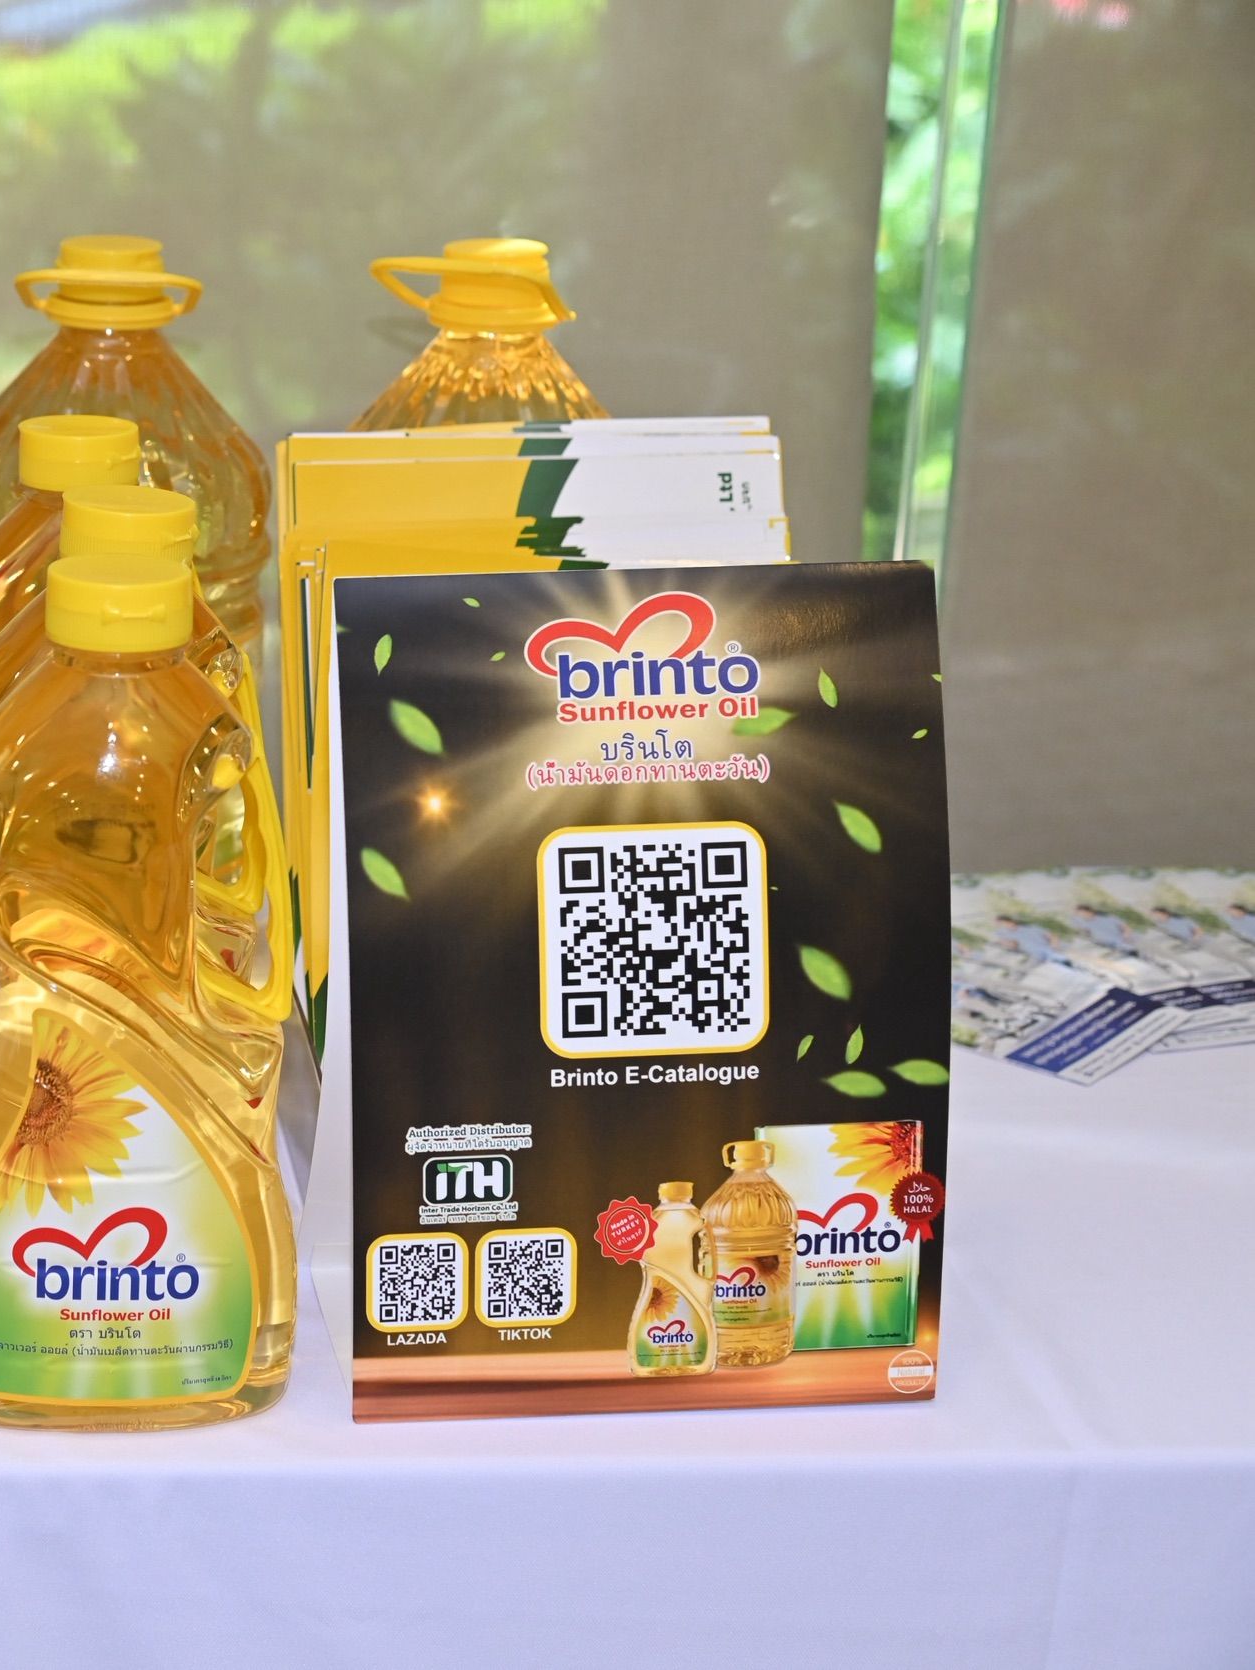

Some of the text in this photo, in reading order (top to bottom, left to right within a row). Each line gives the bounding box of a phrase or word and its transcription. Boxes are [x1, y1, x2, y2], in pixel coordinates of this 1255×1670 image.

[557, 650, 759, 698] brinto
[559, 697, 757, 722] Sunflower Oil
[601, 730, 692, 760] บรินโต
[550, 1064, 760, 1088] Brinto E-Catalogue
[409, 1127, 466, 1138] Authorized
[904, 1194, 934, 1204] 100%
[441, 1205, 460, 1213] Trade
[462, 1204, 490, 1212] Horizon
[611, 1219, 639, 1237] TURKEY
[806, 1257, 881, 1269] Sunflower Oil
[36, 1259, 200, 1301] brinto
[716, 1284, 766, 1297] brinto
[60, 1308, 171, 1322] Sunflower Oil
[69, 1327, 142, 1340] ตรา บรินโต
[387, 1332, 447, 1346] LAZADA
[498, 1327, 552, 1341] TIKTOK
[653, 1332, 694, 1343] brinto
